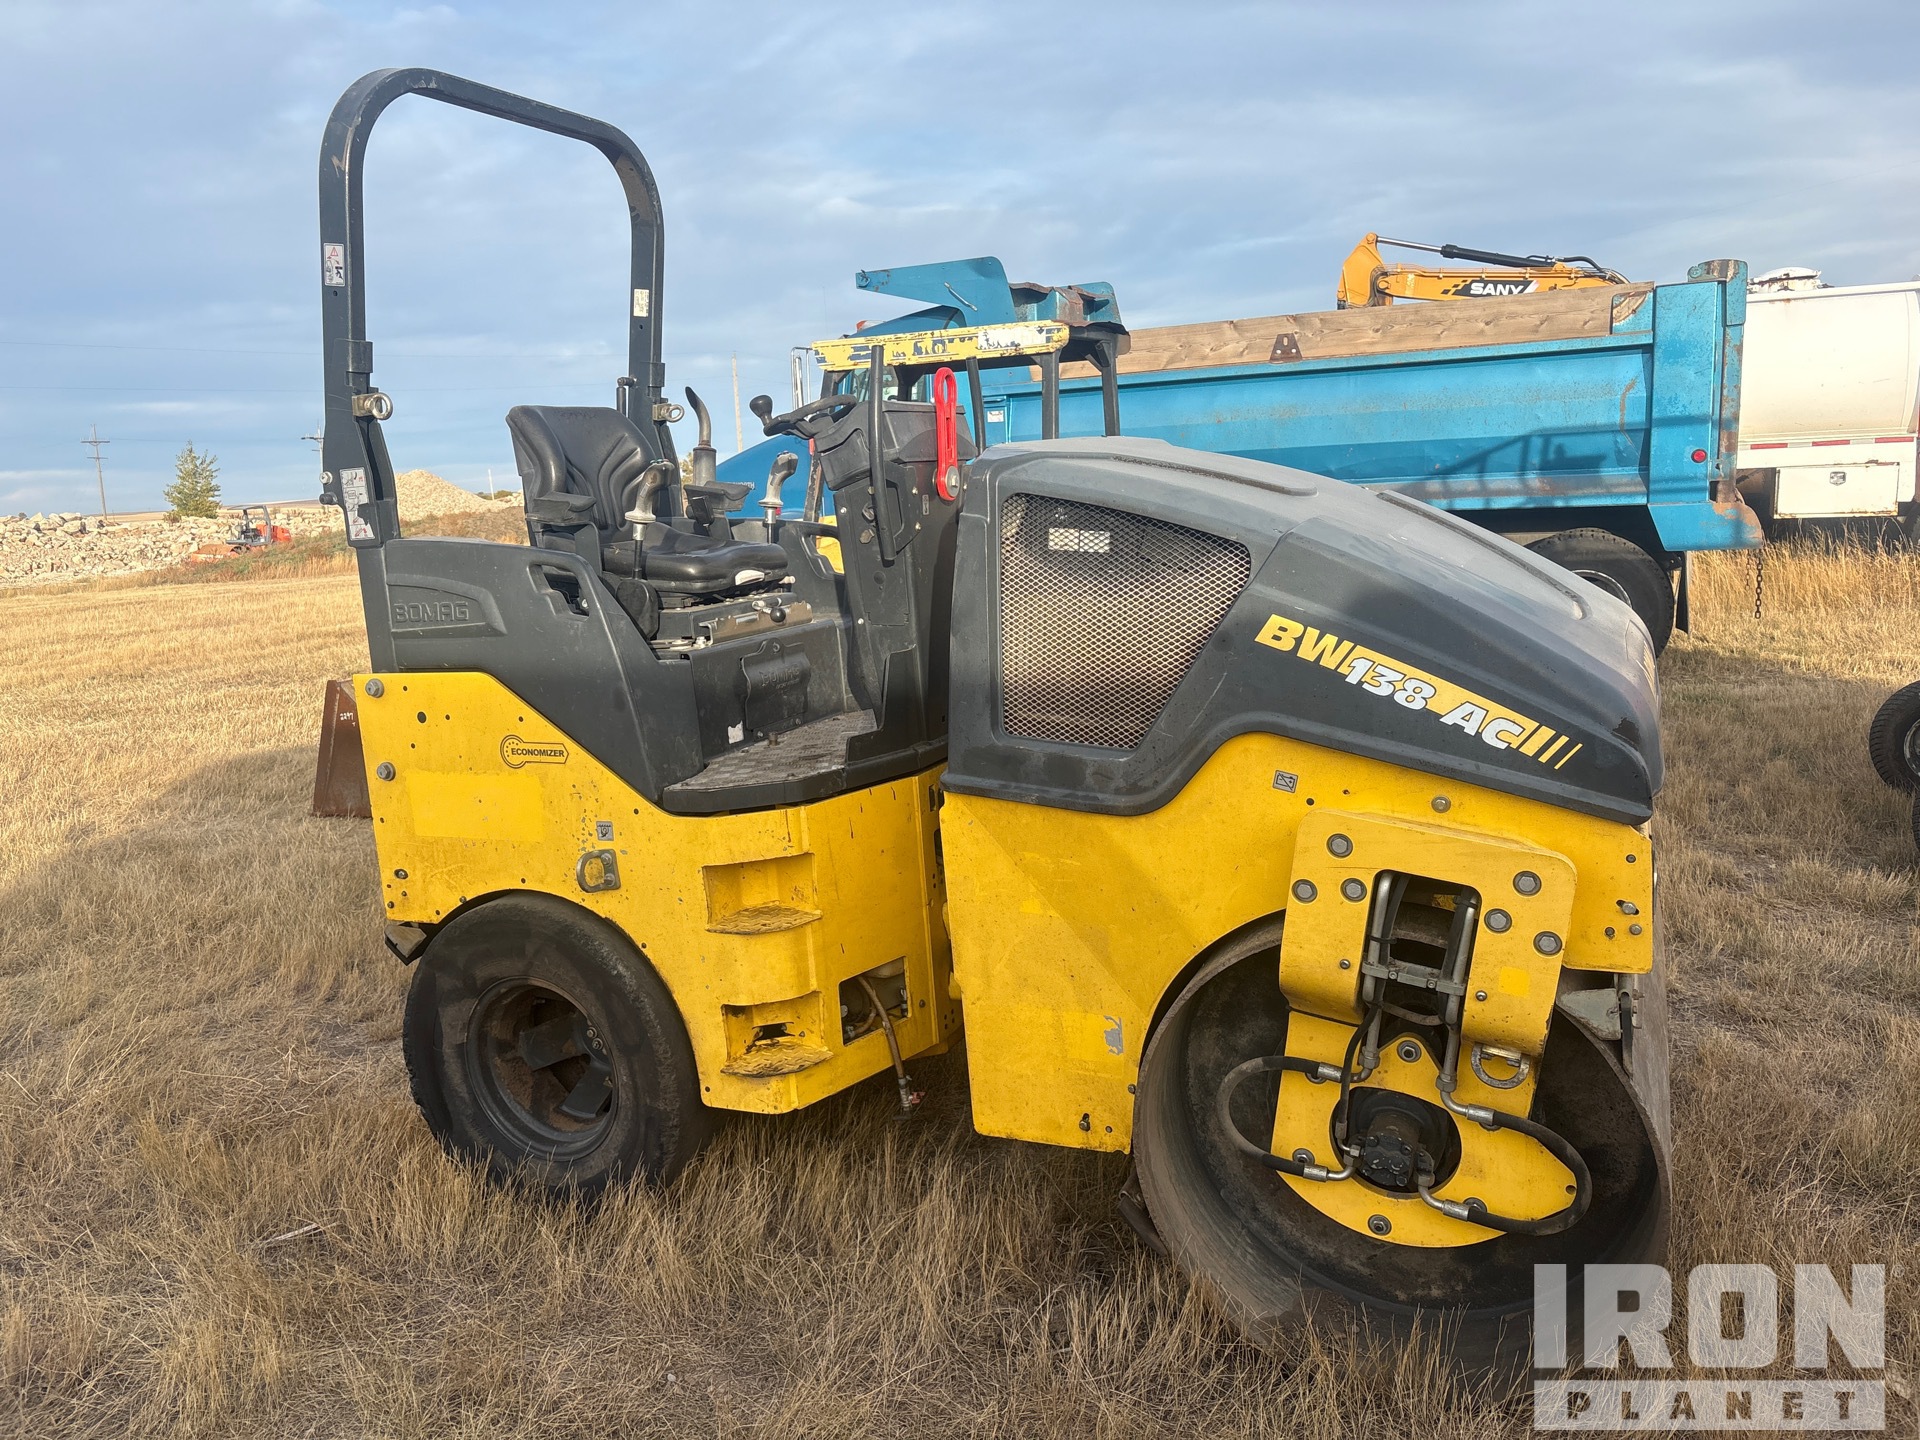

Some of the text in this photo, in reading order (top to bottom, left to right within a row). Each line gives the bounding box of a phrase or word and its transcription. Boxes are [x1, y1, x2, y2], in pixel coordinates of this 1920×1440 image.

[1470, 282, 1523, 295] SANY
[393, 601, 469, 623] BOMAG
[511, 747, 565, 758] ECONOMIZER
